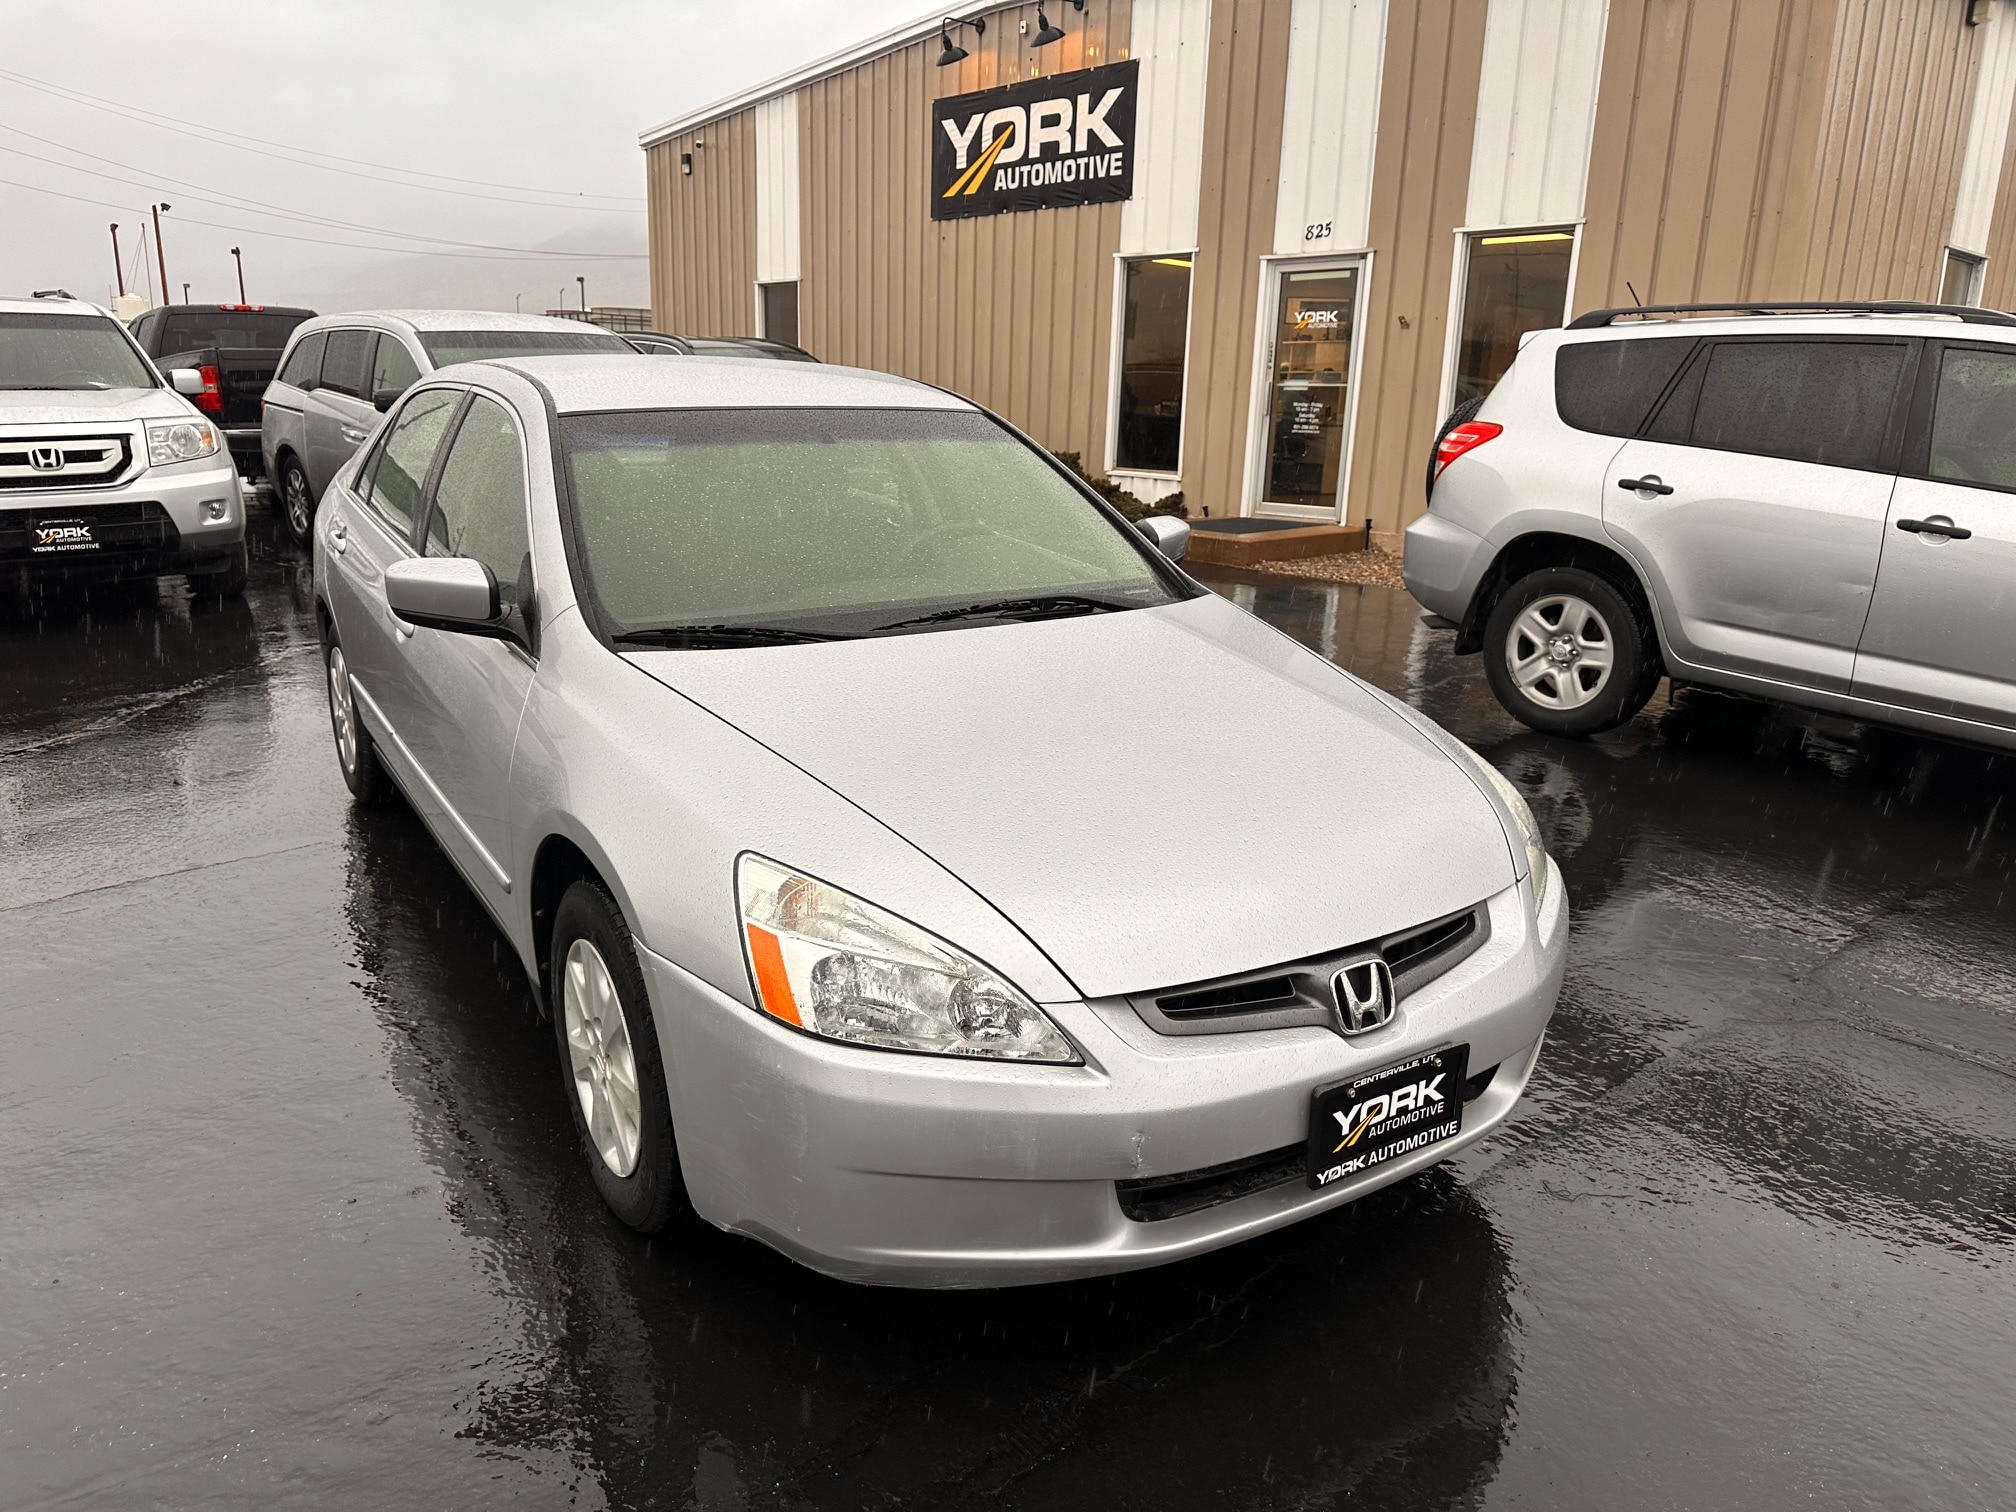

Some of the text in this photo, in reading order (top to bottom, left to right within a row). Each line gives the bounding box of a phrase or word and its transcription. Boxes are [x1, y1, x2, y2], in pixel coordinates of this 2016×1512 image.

[941, 86, 1125, 170] YORK
[994, 152, 1123, 191] AUTOMOTIVE
[1305, 221, 1332, 241] 825
[1294, 310, 1338, 323] YORK
[35, 526, 91, 539] YORK
[56, 543, 100, 551] AUTOMOTIVE
[1353, 1054, 1437, 1089] CENTERVILLE, UT
[1332, 1072, 1447, 1137] YORK
[1368, 1101, 1445, 1139] AUTOMOTIVE
[1316, 1120, 1458, 1185] YORK AUTOMOTIVE
